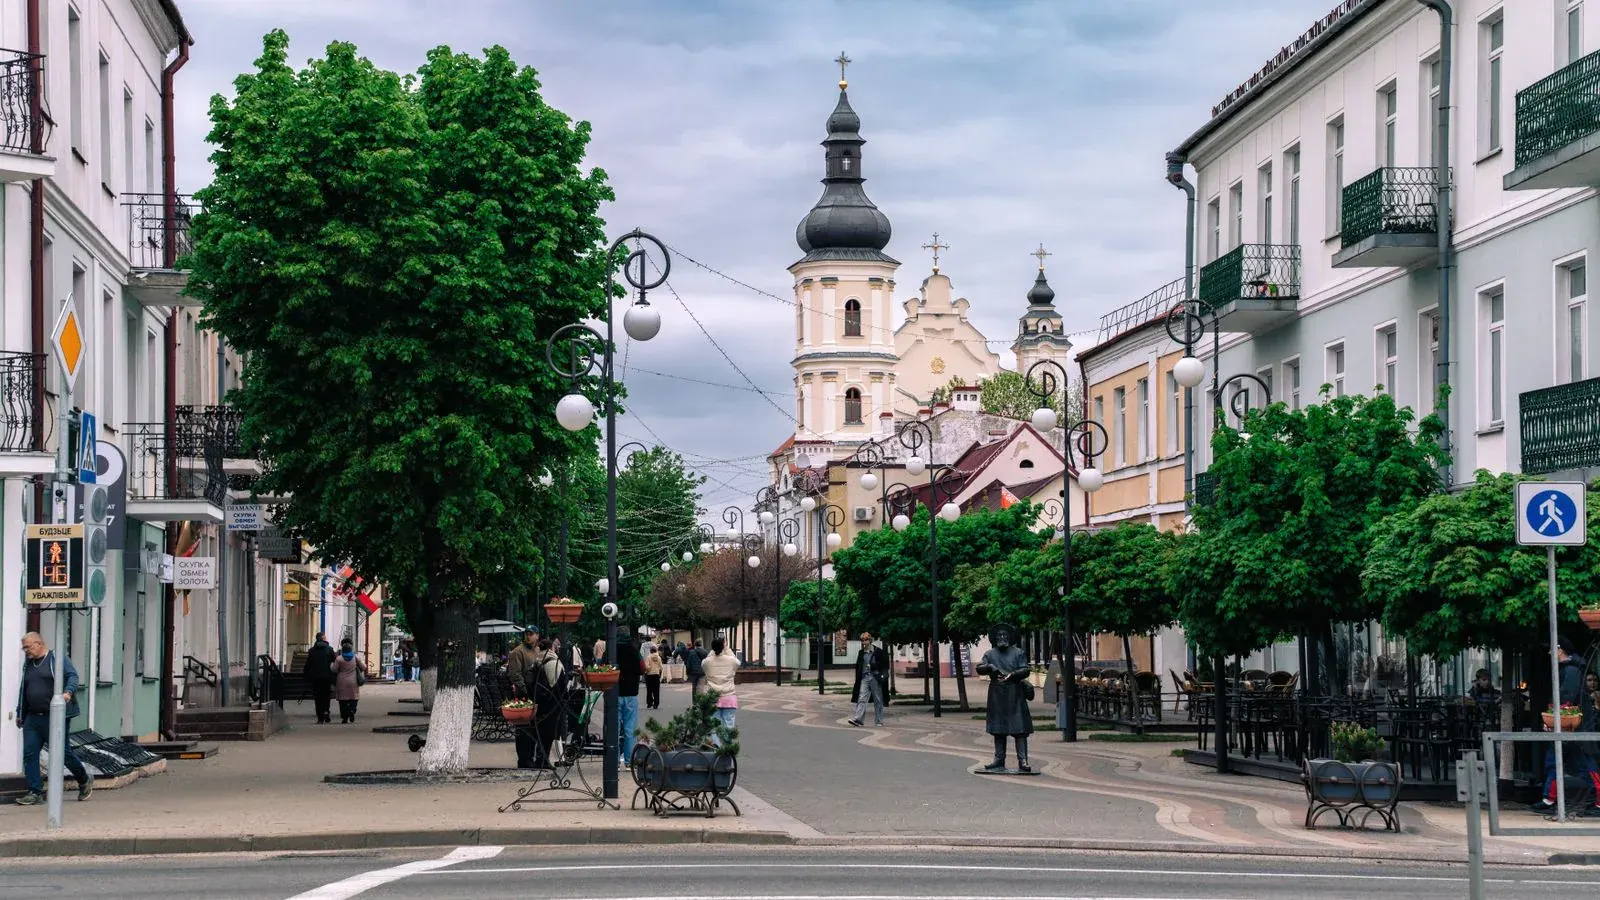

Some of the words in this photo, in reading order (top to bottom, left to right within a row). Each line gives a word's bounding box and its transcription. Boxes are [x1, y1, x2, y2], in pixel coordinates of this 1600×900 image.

[39, 527, 72, 536] БУДЗЬЦЕ
[43, 564, 67, 584] 46
[180, 569, 208, 577] ОБМЕН
